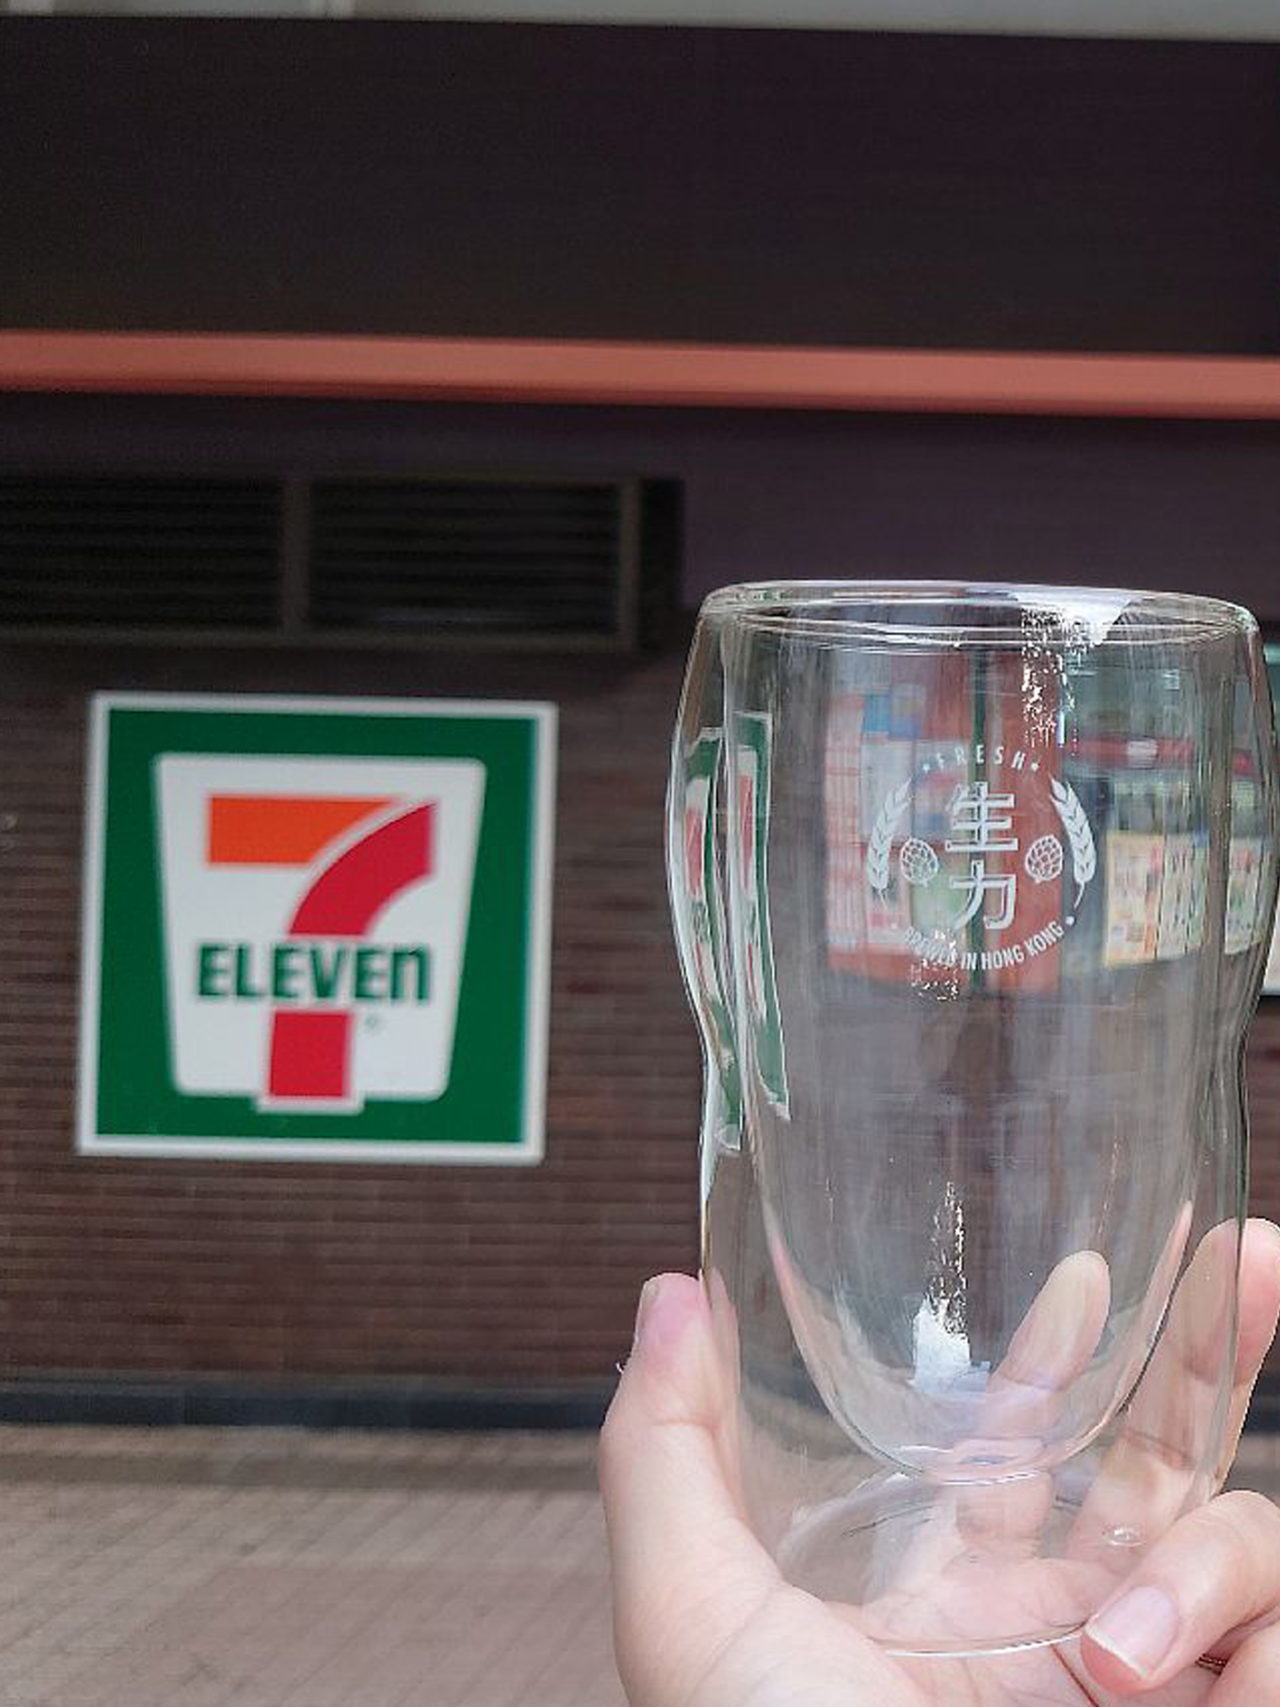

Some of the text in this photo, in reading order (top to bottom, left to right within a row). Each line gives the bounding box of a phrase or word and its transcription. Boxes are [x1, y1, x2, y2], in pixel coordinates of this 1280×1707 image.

[936, 744, 1026, 771] FRESH
[944, 781, 1019, 930] 生力
[960, 951, 977, 970] IN
[980, 945, 1024, 970] HONG
[1023, 920, 1065, 957] KONG
